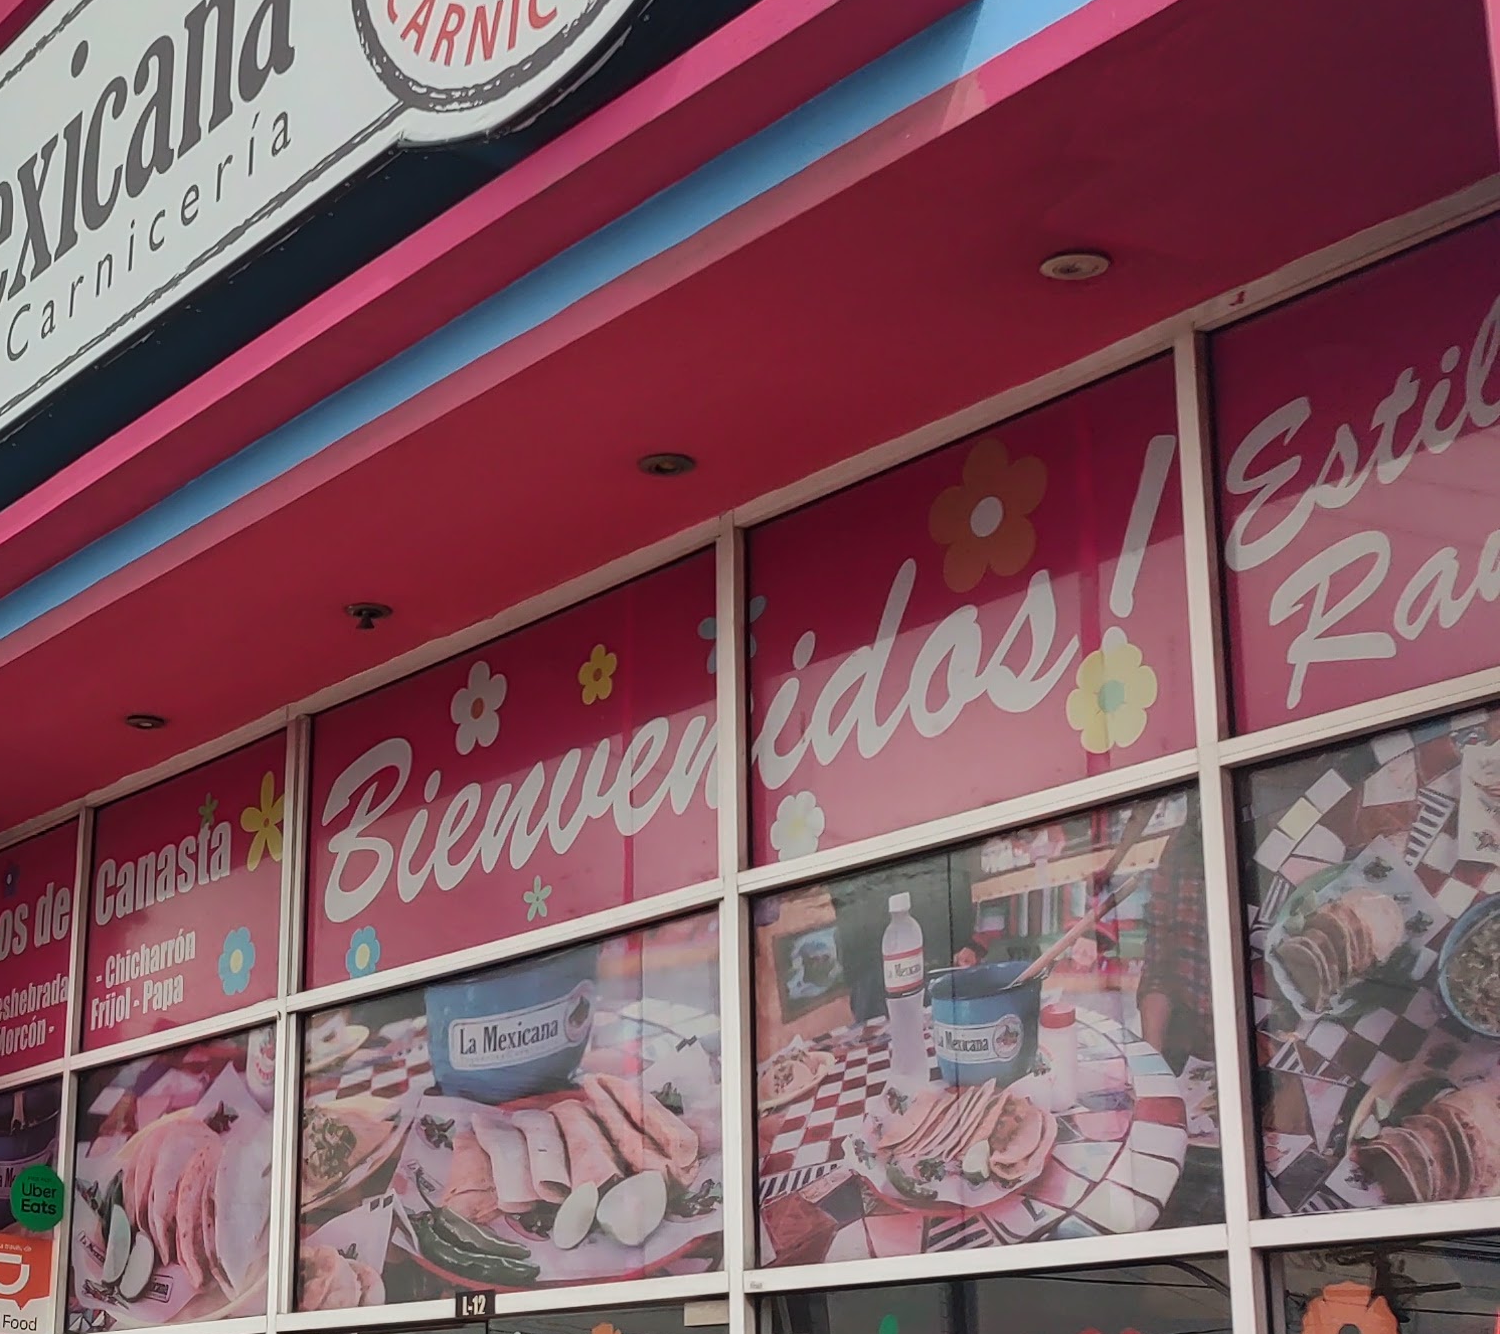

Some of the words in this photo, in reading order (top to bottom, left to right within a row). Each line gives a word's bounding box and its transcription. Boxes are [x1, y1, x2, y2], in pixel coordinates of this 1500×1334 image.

[33, 882, 71, 949] de
[95, 821, 232, 926] Canasta
[105, 928, 196, 989] Chicharrón
[90, 988, 131, 1032] Frijol
[142, 974, 184, 1015] Papa
[460, 1028, 477, 1055] La
[483, 1019, 559, 1054] Mexicana
[21, 1182, 57, 1198] Uber
[21, 1198, 57, 1215] Eats
[462, 1294, 486, 1317] L-12
[2, 1314, 38, 1332] Food
